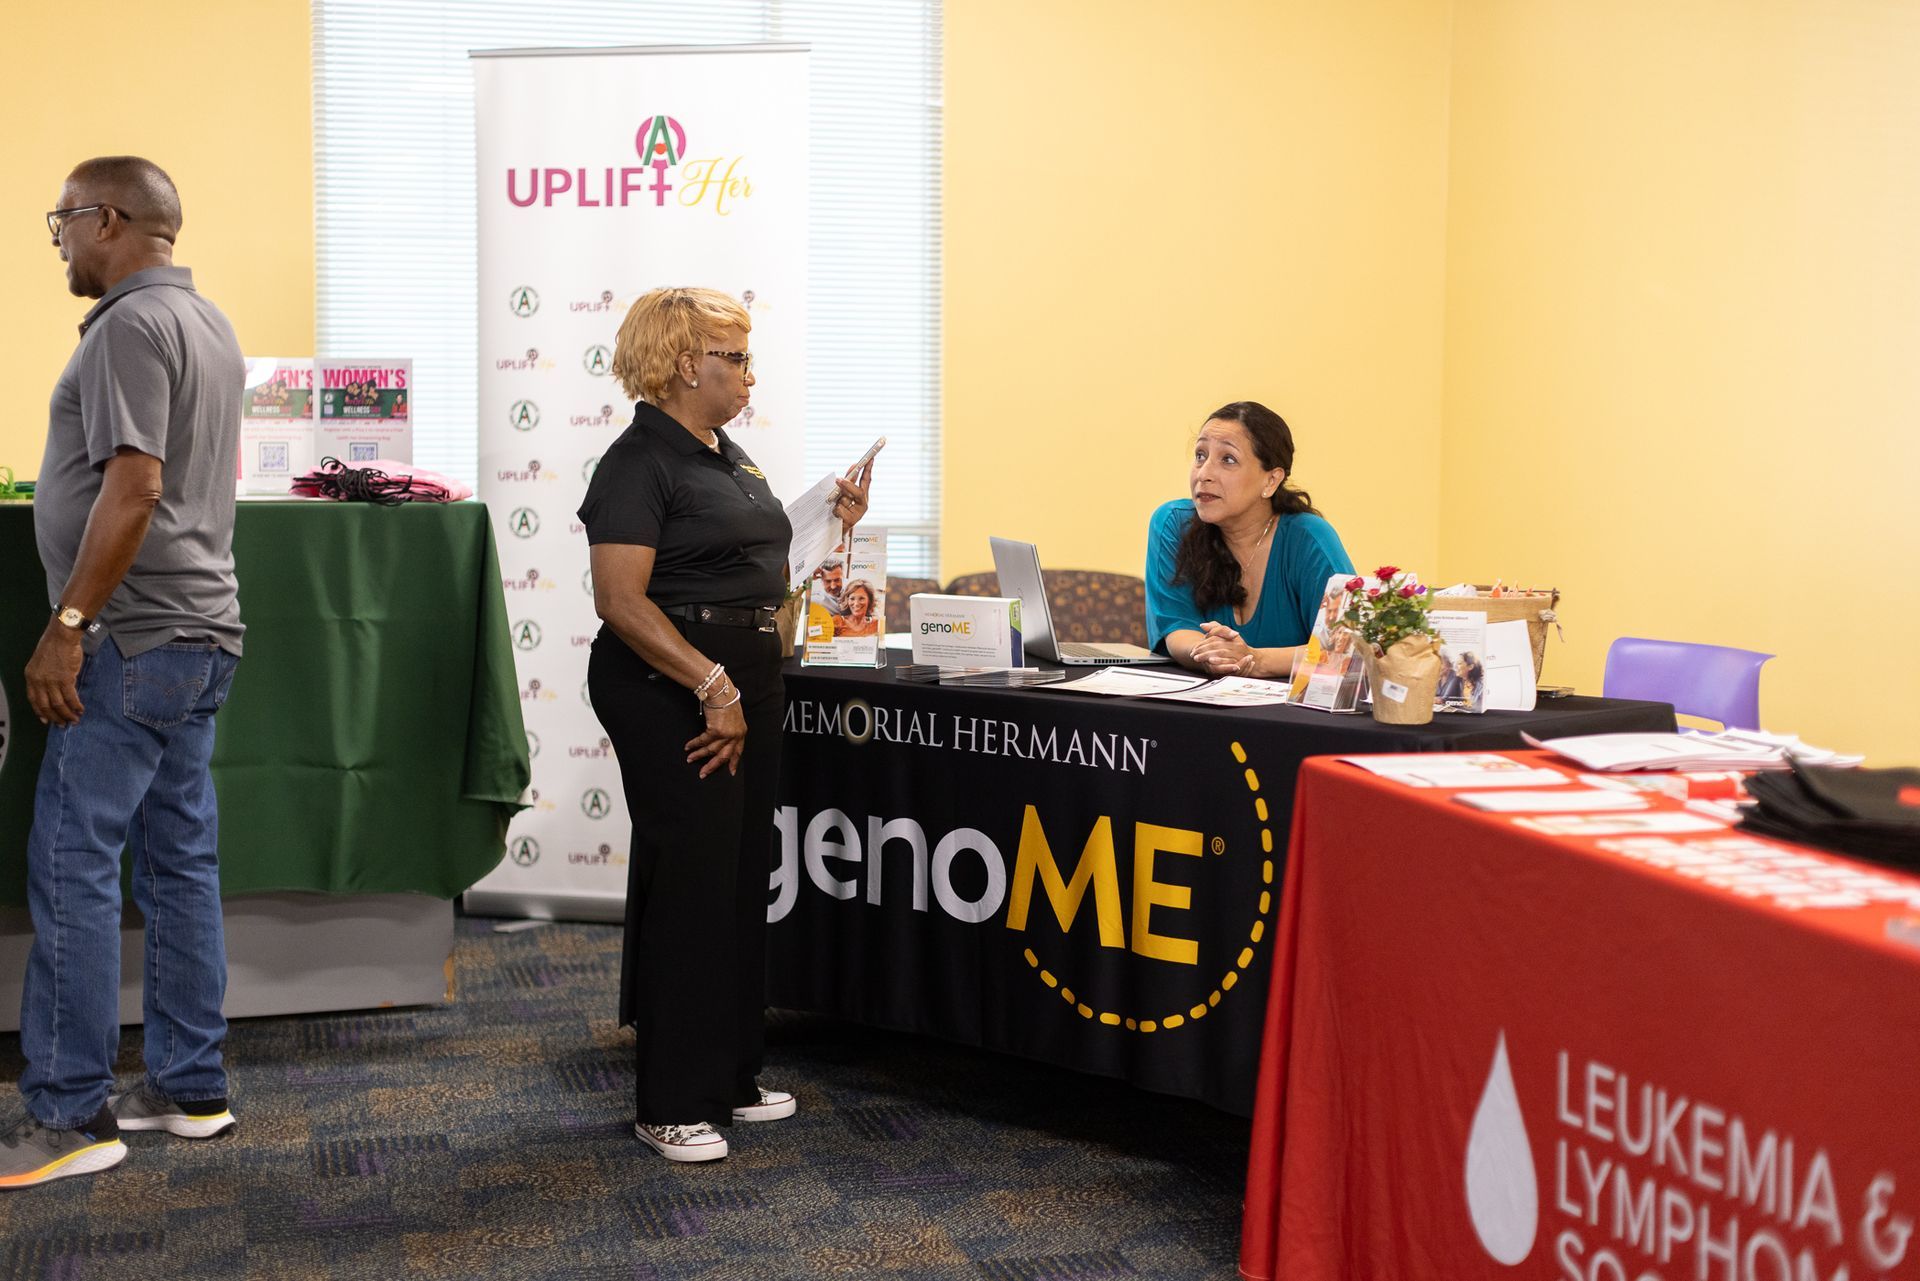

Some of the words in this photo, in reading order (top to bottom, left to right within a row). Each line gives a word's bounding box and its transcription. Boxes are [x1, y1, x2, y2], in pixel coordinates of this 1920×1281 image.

[506, 160, 673, 208] UPLIFT
[678, 155, 755, 216] Her
[504, 579, 537, 591] PLIFT
[920, 621, 971, 635] genoME
[1557, 1049, 1843, 1247] LEUKEMIA
[1862, 1172, 1914, 1269] &
